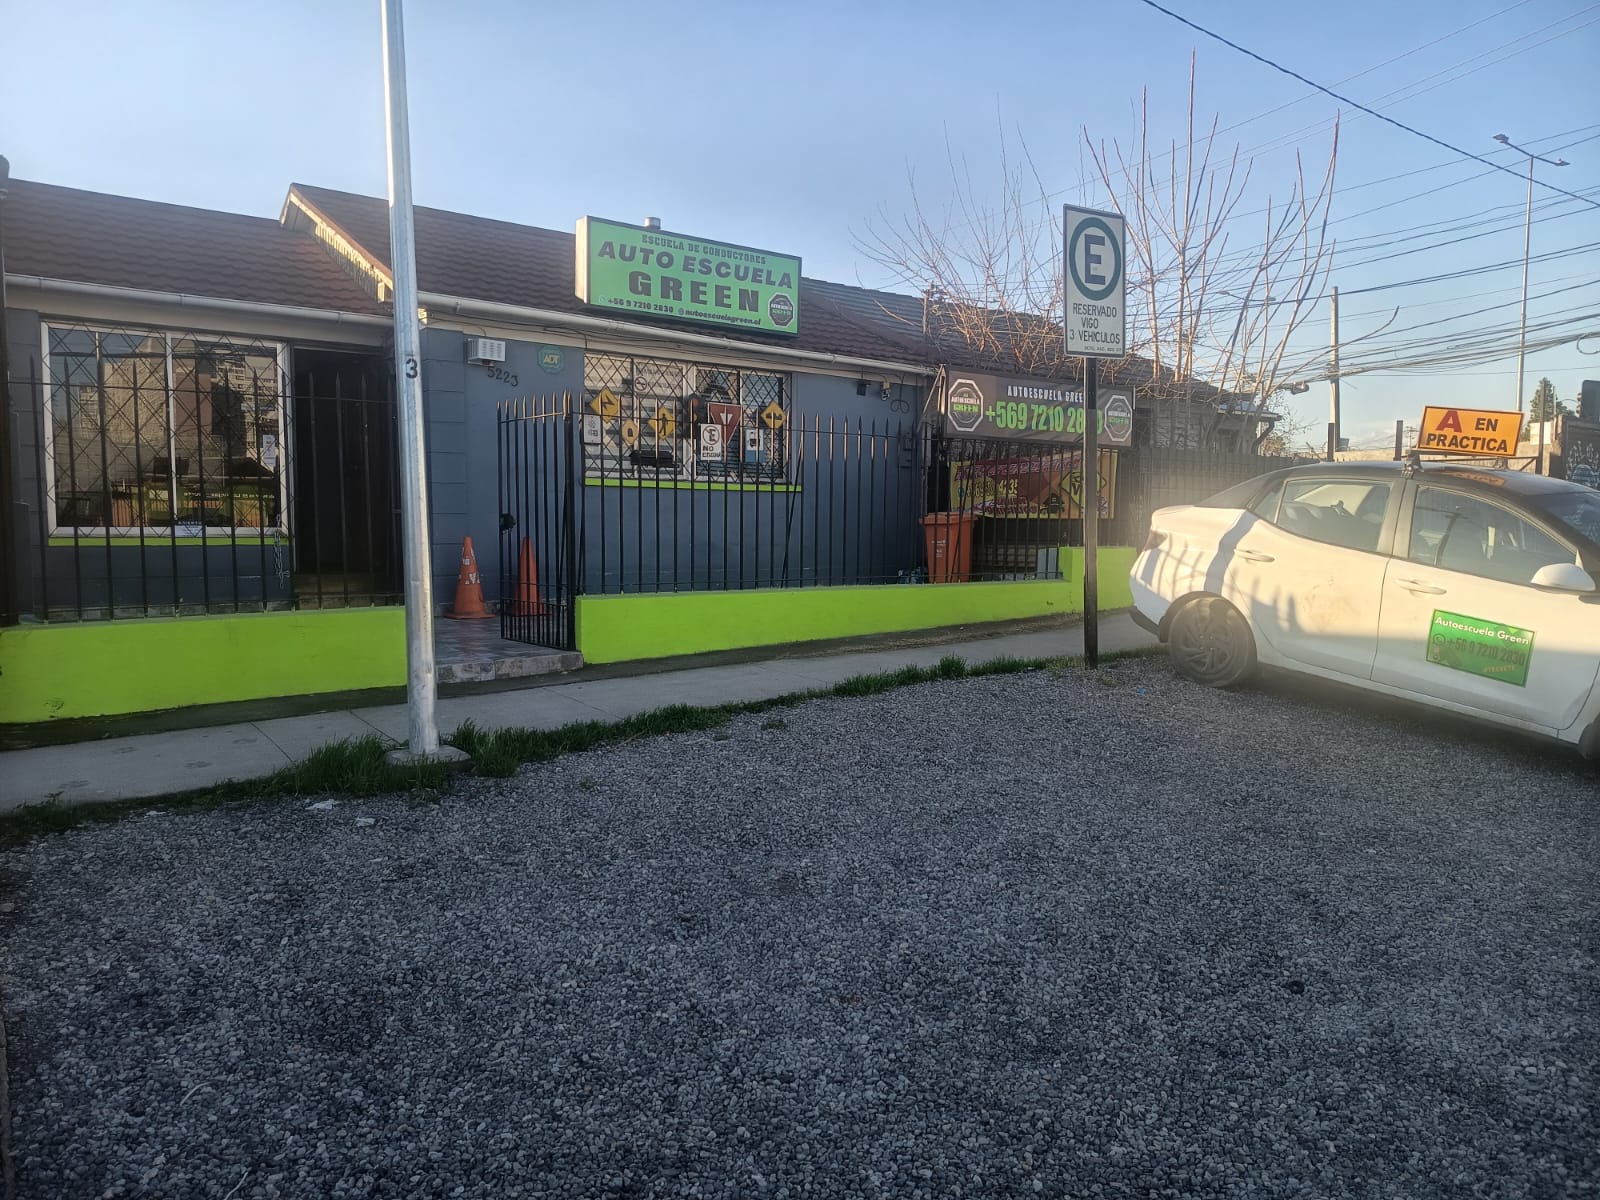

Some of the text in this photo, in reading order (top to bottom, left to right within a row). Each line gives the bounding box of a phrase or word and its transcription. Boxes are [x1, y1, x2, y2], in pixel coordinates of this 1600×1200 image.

[641, 234, 766, 265] ESCUELA DE CONDUCTORES
[1084, 233, 1106, 286] E
[598, 240, 793, 289] AUTO ESCUELA
[628, 270, 759, 313] GREEN
[608, 297, 624, 308] +56
[626, 298, 633, 308] 9
[633, 300, 652, 311] 7210
[1072, 302, 1117, 318] RESERVADO
[1081, 317, 1099, 329] VIGO
[1069, 328, 1121, 345] 3 VEHICULOS
[405, 358, 418, 379] 3
[1007, 385, 1084, 404] AUTOESCUELA GREE
[985, 401, 1103, 435] +569 7210 280
[1435, 410, 1498, 433] A EN
[1425, 433, 1508, 453] PRACTICA
[1435, 616, 1529, 645] Autoescuela Green
